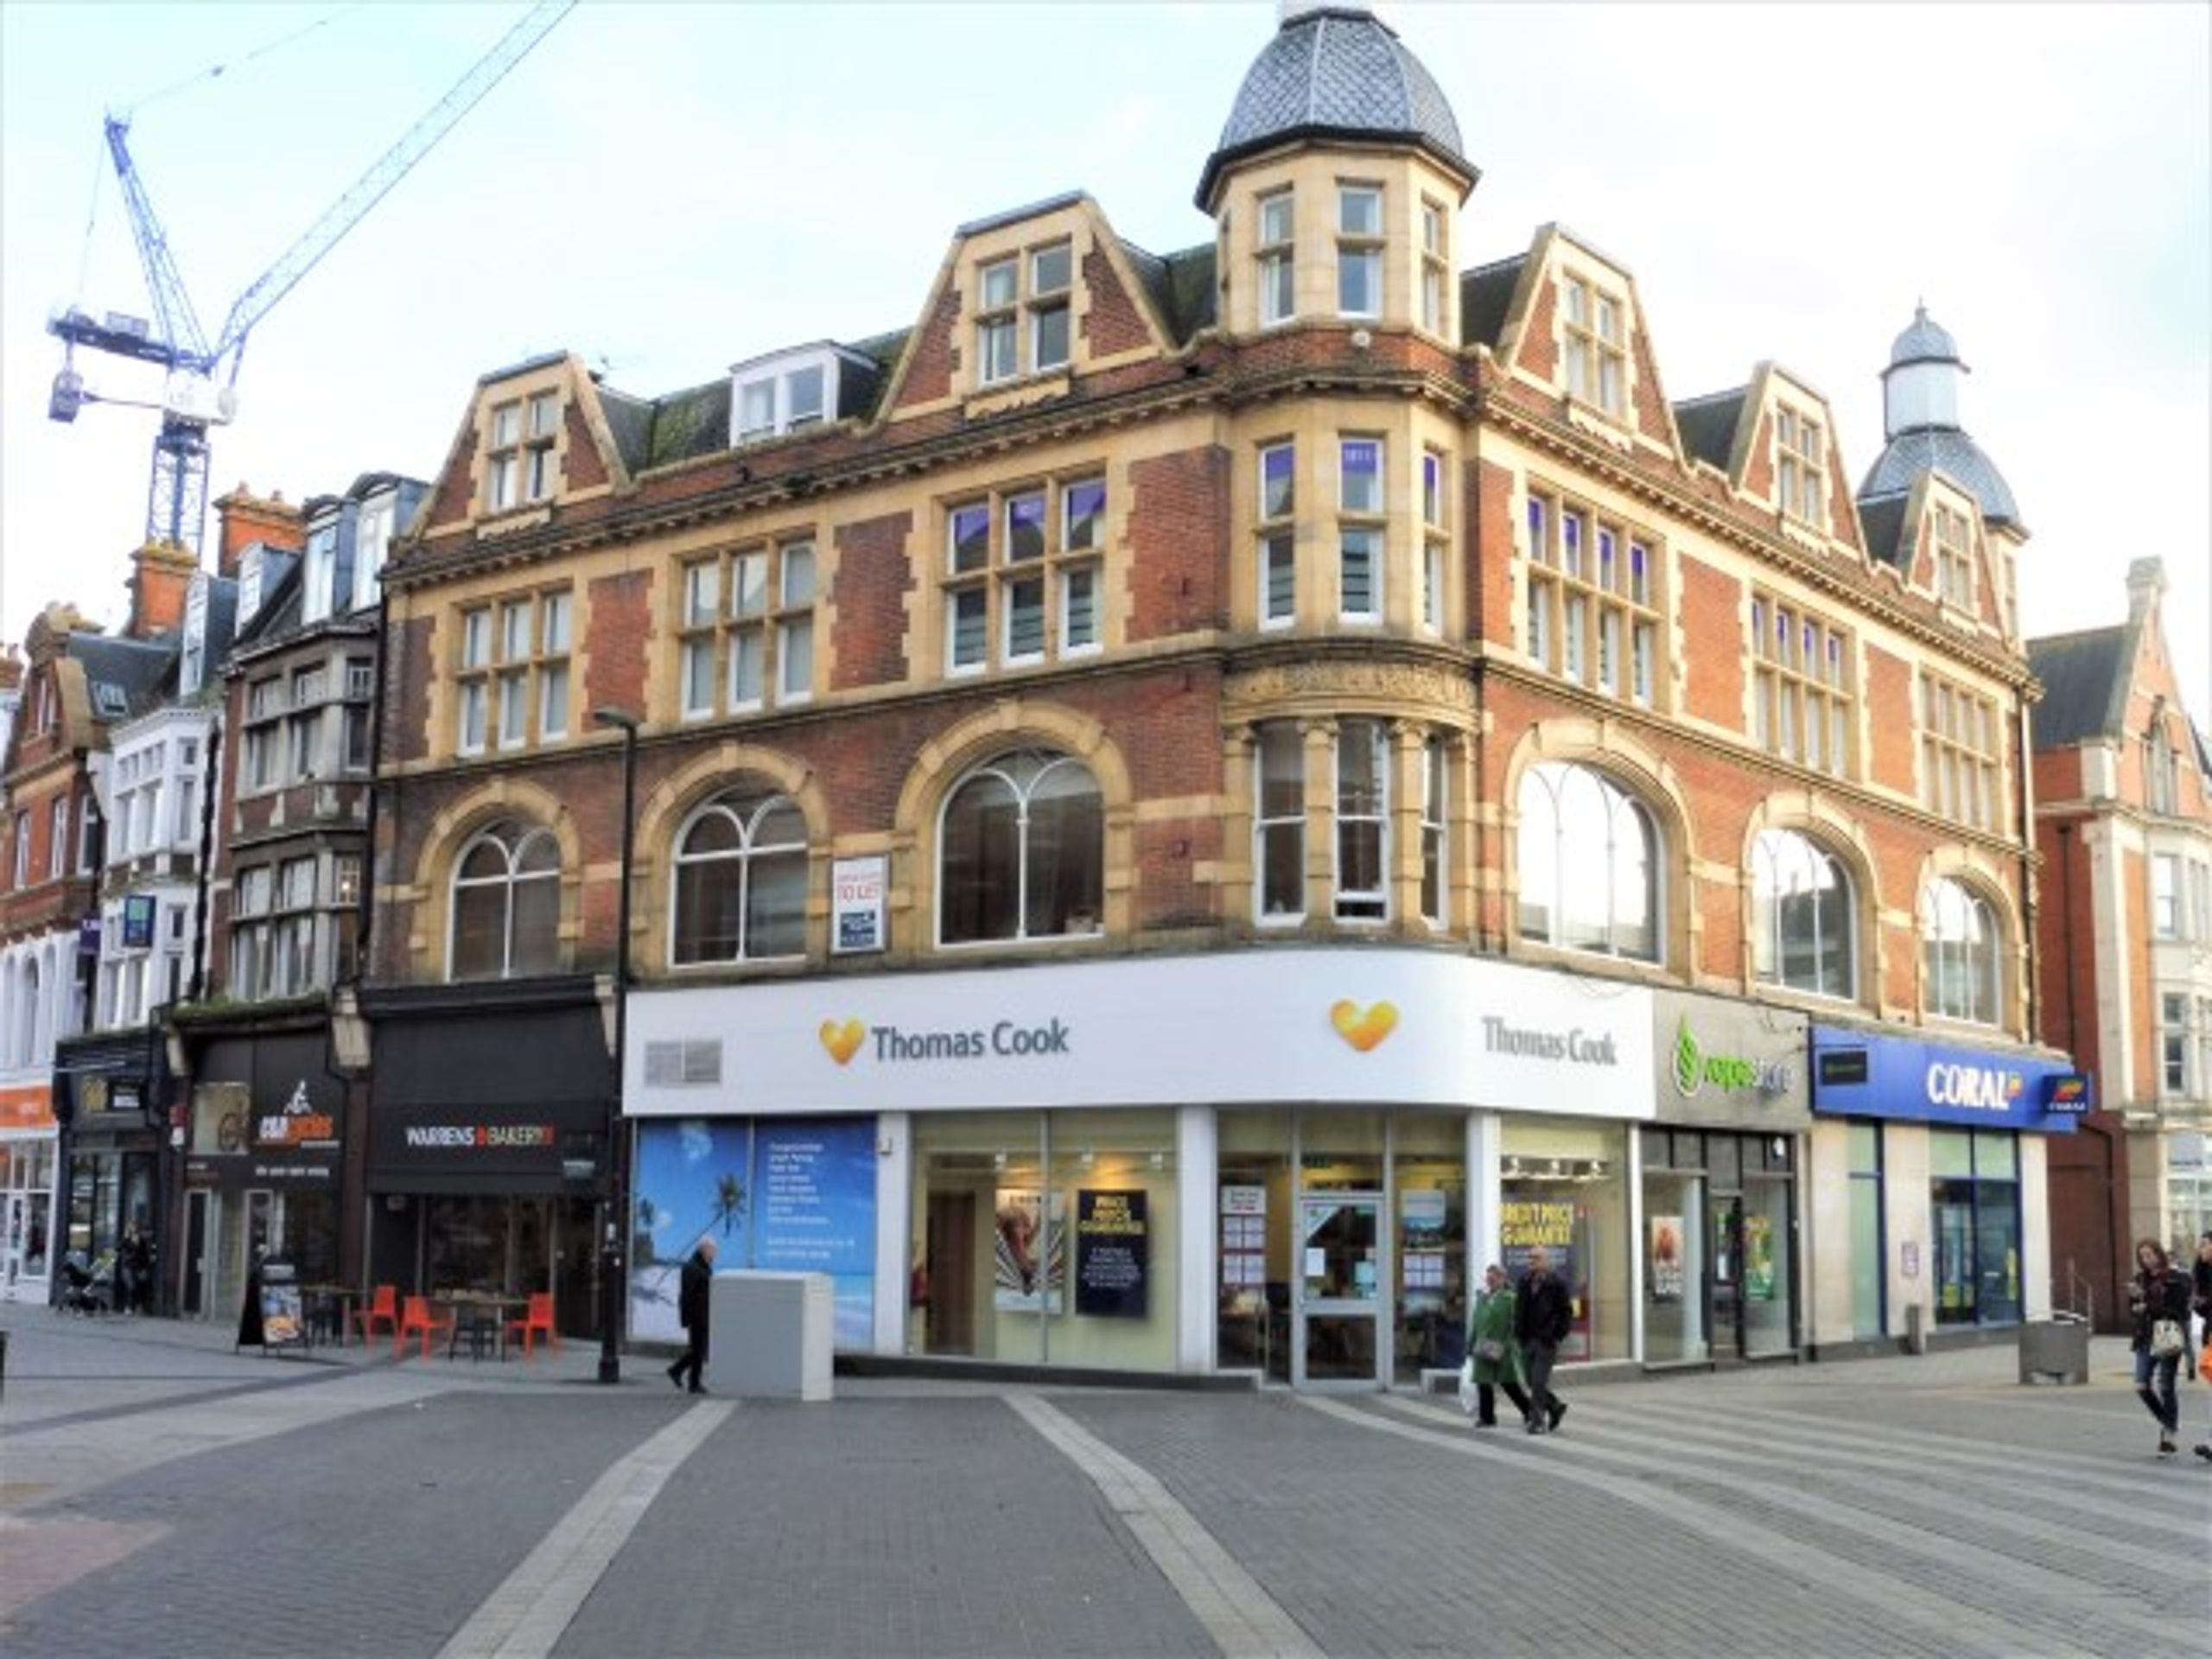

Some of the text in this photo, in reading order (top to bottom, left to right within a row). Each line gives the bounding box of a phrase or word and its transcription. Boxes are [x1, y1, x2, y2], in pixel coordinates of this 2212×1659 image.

[871, 1017, 1070, 1061] Thomas Cook
[1482, 1015, 1618, 1065] Thomas Cook
[1928, 1064, 2009, 1110] CORAL
[406, 1126, 544, 1145] WARRENS BAKERY
